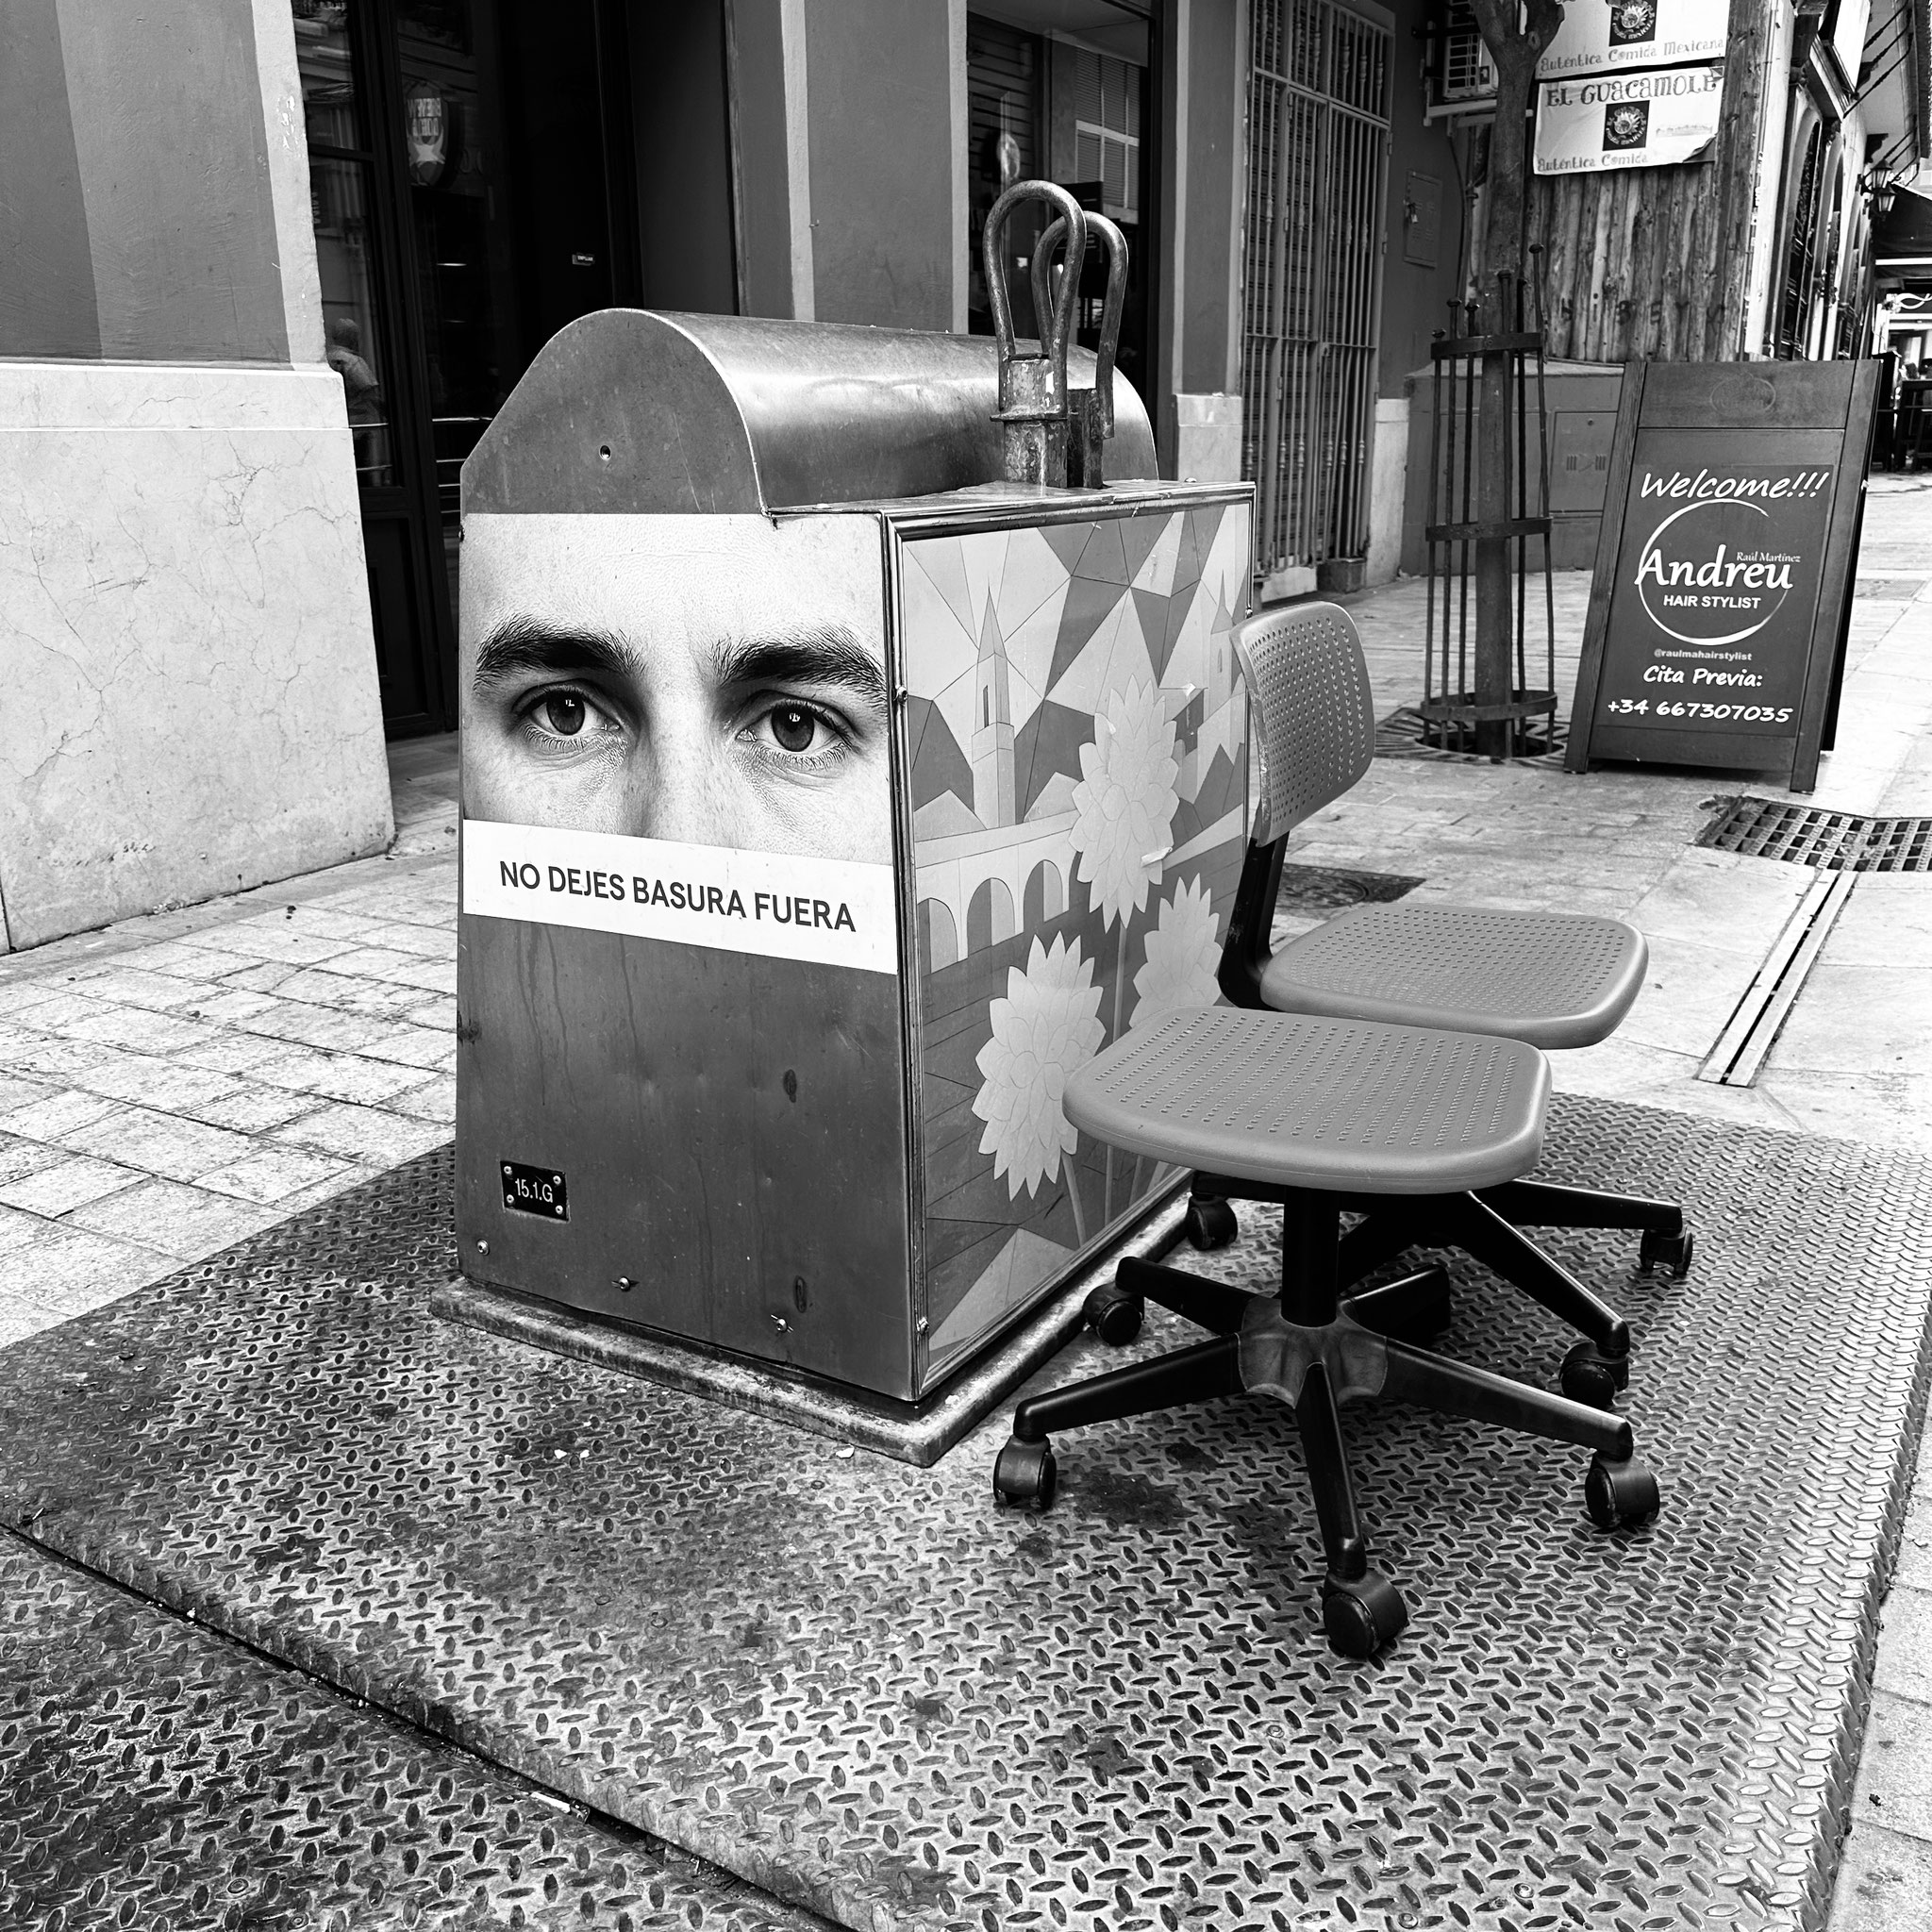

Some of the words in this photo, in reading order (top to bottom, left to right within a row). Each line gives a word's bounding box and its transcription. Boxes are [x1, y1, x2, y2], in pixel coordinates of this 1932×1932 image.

[1608, 44, 1657, 62] Comida
[1663, 39, 1724, 57] Mexicana
[1546, 89, 1574, 107] EL
[1602, 152, 1649, 167] Comida
[1641, 468, 1830, 499] Welcome!!!
[1634, 543, 1794, 590] Andreu
[1663, 594, 1698, 608] HAIR
[1701, 595, 1762, 609] STYLIST
[1654, 648, 1753, 662] @raulmahairstylist
[1642, 664, 1685, 684] Cita
[1691, 668, 1763, 688] Previa:
[1607, 699, 1649, 715] +34
[1656, 701, 1793, 724] 667307035
[499, 860, 541, 890] NO
[547, 865, 625, 901] DEJES
[632, 876, 747, 918] BASURA
[755, 892, 857, 933] FUERA
[514, 1177, 554, 1204] 15.1.G
